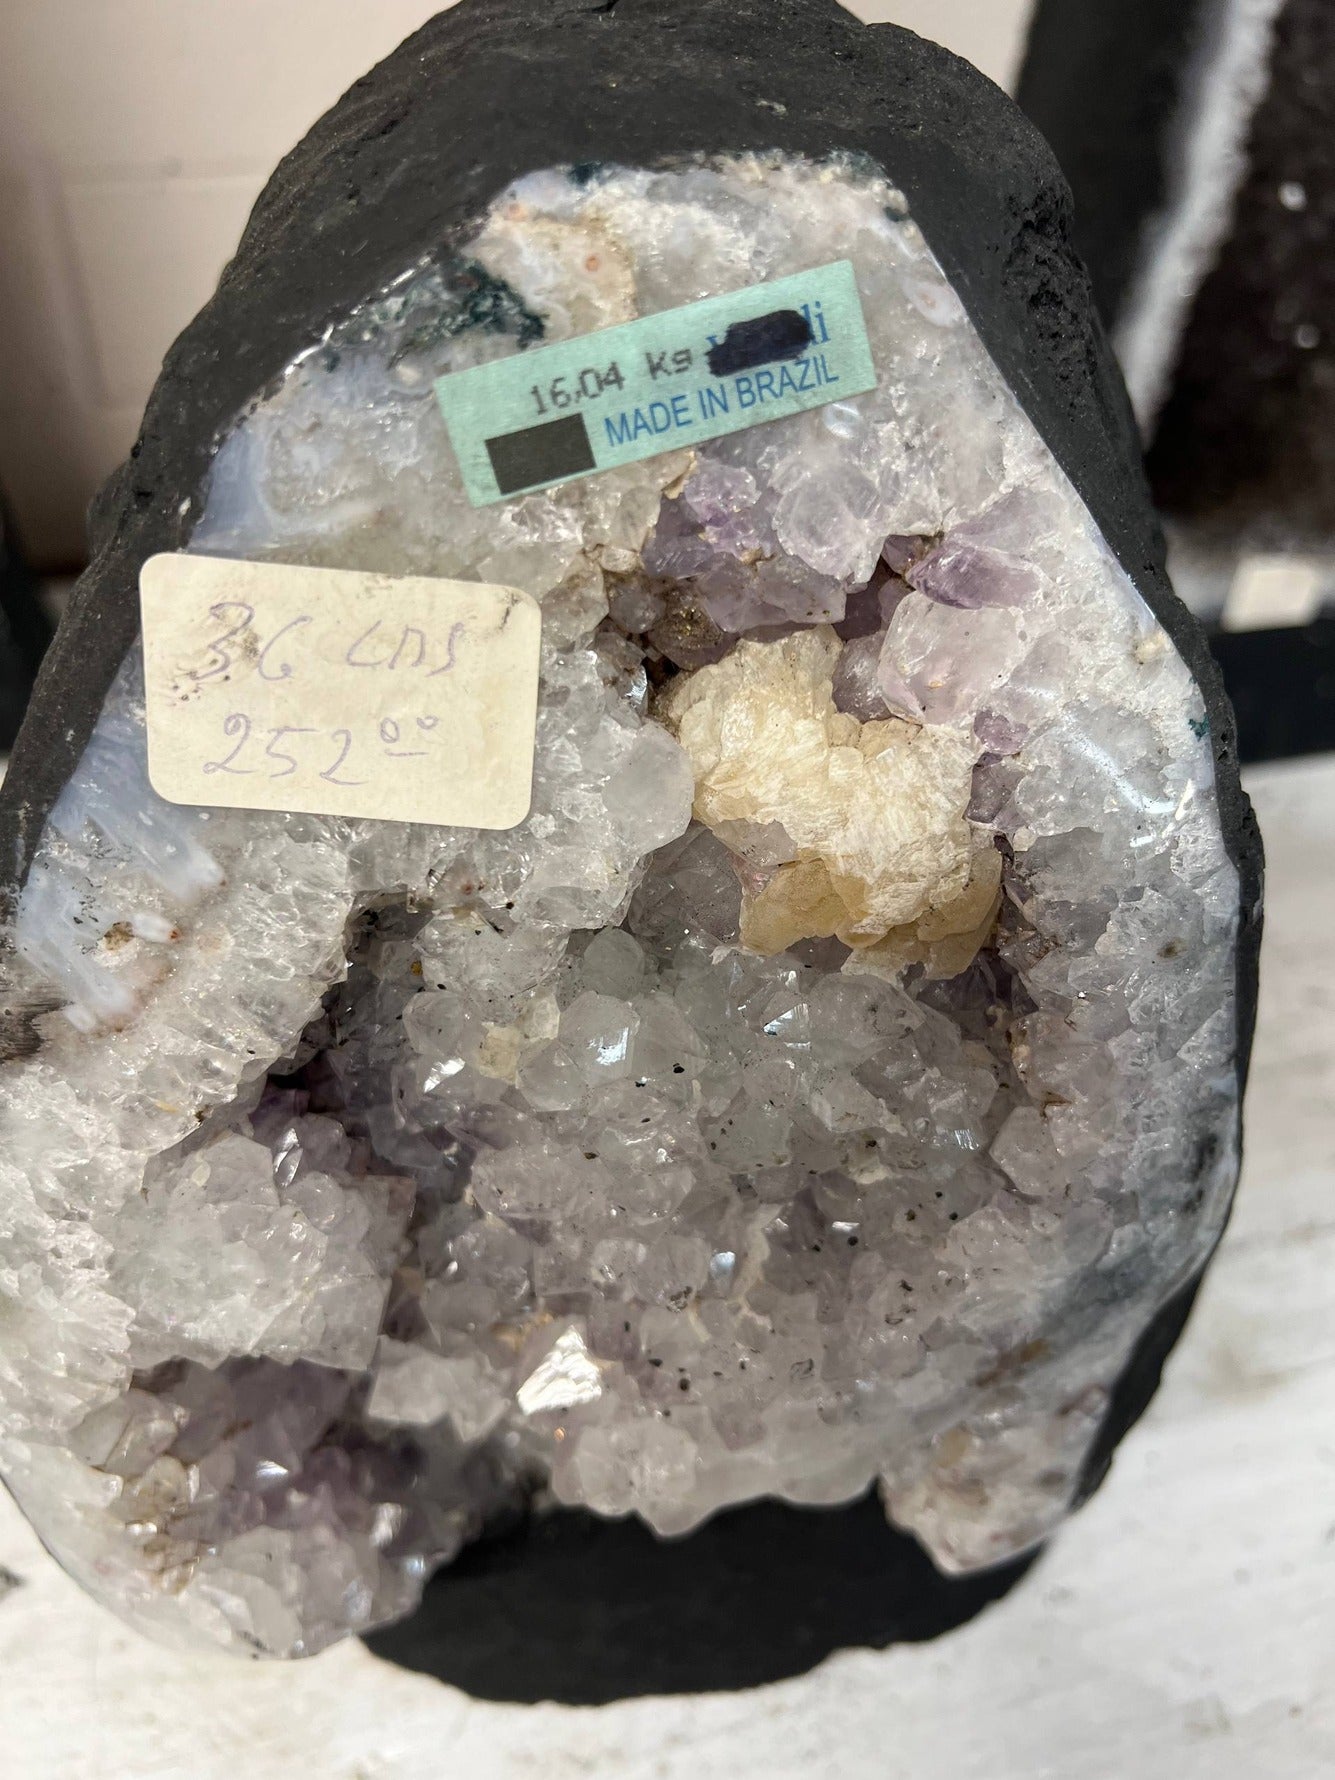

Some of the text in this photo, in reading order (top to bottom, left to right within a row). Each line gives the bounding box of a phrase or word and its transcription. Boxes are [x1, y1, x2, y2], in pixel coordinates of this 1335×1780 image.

[603, 354, 840, 448] MADE IN BRAZIL
[189, 601, 313, 681] 36
